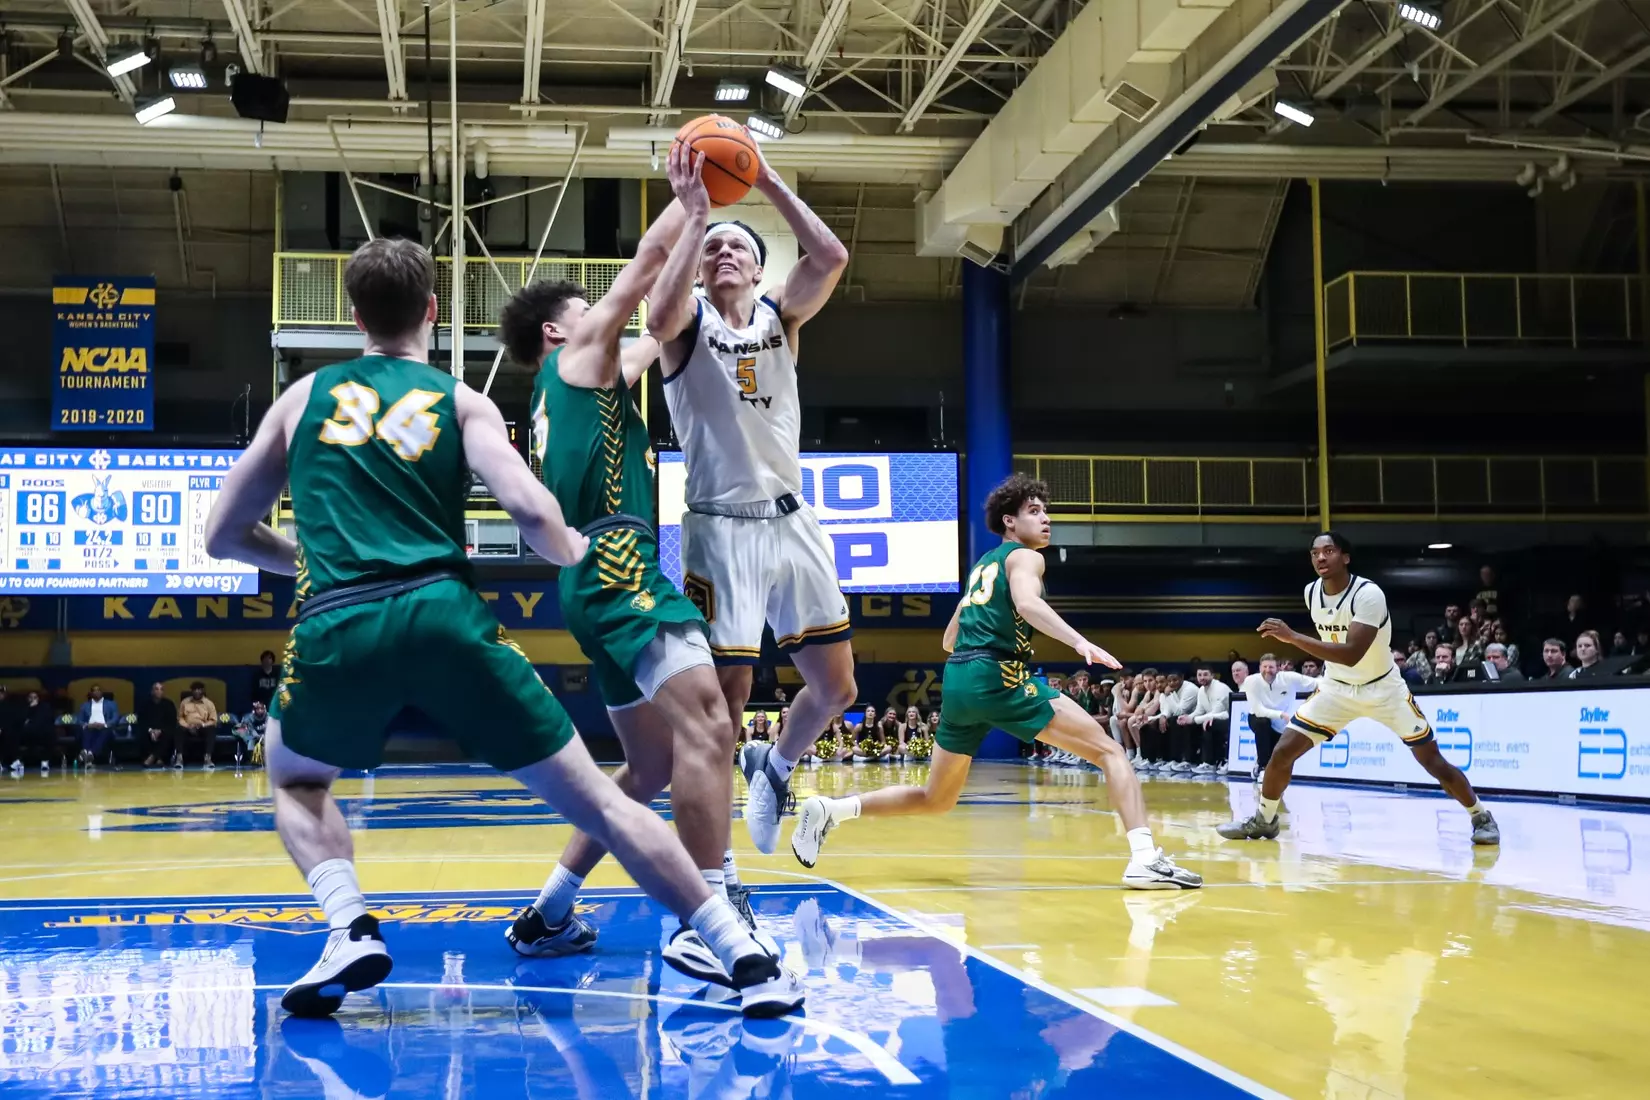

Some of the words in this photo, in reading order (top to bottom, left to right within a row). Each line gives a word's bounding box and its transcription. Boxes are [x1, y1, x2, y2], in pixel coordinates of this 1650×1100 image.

[57, 312, 113, 320] KANSAS
[118, 312, 151, 321] CITY
[99, 321, 138, 329] BASKETBALL
[60, 347, 147, 373] NCAA
[60, 375, 147, 389] TOURNAMENT
[737, 357, 757, 394] 5
[60, 409, 145, 424] 2019-2020
[318, 381, 446, 462] 34
[35, 454, 82, 466] CITY
[117, 454, 238, 467] BASKETBAL
[22, 479, 65, 487] ROOS
[141, 480, 172, 489] VISITOR
[190, 477, 210, 489] PLYR
[27, 493, 59, 523] 86
[141, 494, 173, 523] 90
[49, 532, 60, 545] 10
[85, 530, 113, 546] 24.2
[139, 532, 149, 545] 10
[83, 547, 112, 558] OT/2
[84, 560, 111, 568] POSS
[9, 577, 21, 588] TO
[23, 577, 44, 588] OUR
[45, 577, 97, 588] FOUNDING
[98, 577, 149, 588] PARTNERS
[183, 575, 243, 592] evergy
[961, 561, 999, 607] 13
[1318, 624, 1349, 632] ANSA
[1580, 707, 1610, 723] Skyline
